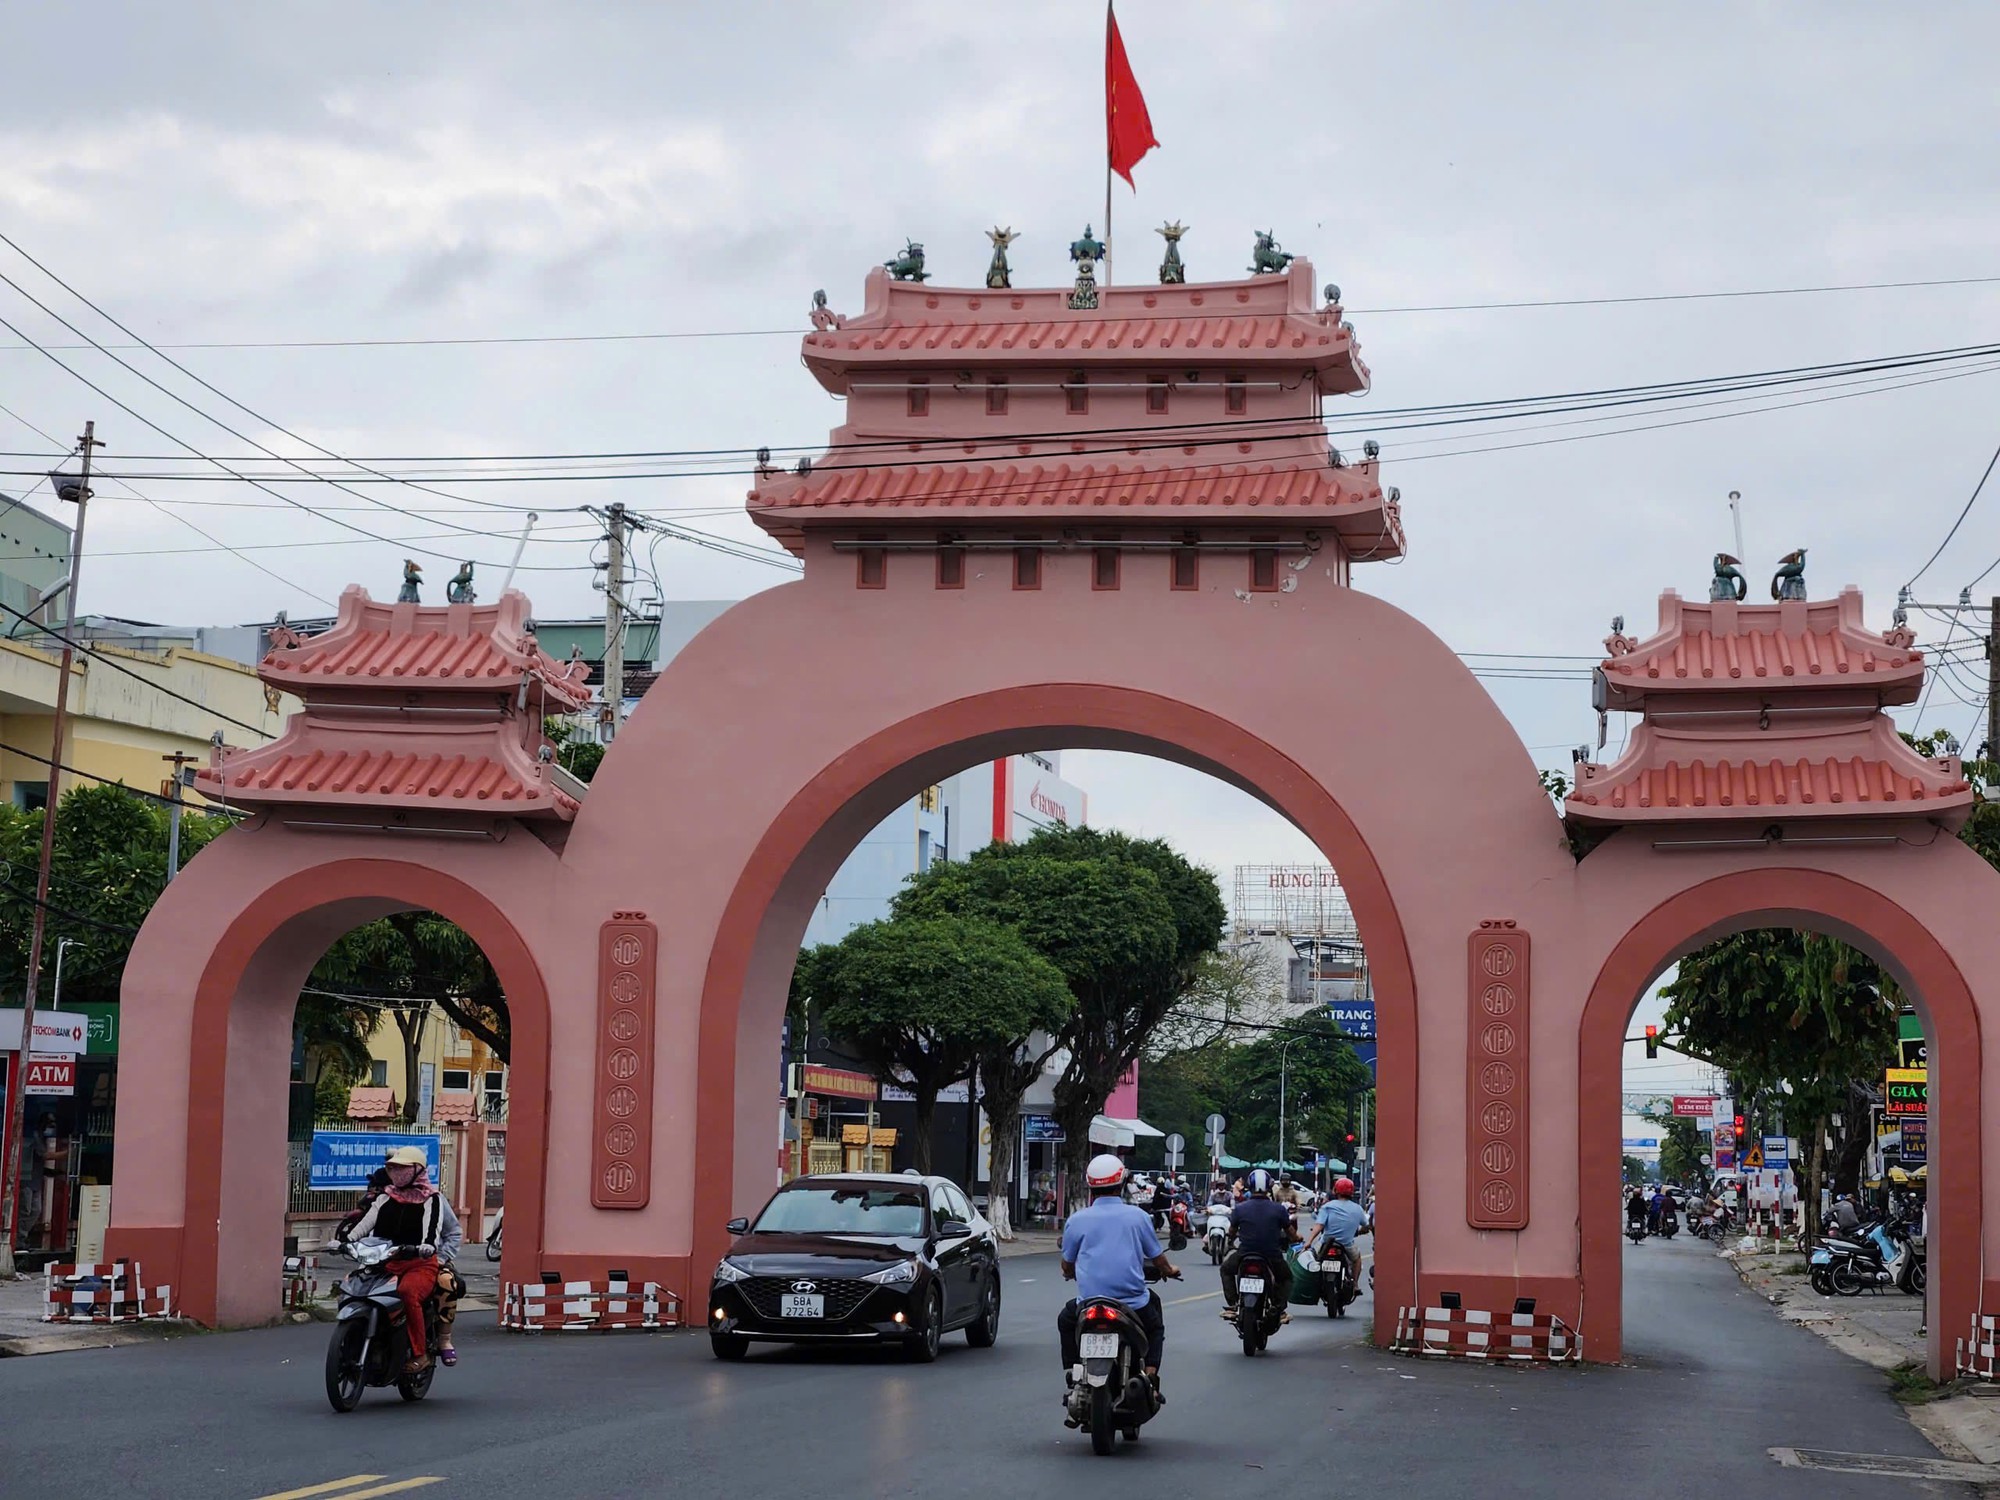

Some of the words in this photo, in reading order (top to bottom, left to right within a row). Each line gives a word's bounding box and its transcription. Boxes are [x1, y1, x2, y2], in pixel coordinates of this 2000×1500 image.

[1269, 868, 1313, 888] HÙNG
[1329, 1009, 1372, 1020] TRANG
[32, 1025, 71, 1038] TECHCOMBANK
[1360, 1022, 1368, 1031] &
[29, 1065, 70, 1082] ATM
[1890, 1084, 1918, 1098] GIÁ
[786, 1307, 819, 1317] 272.64
